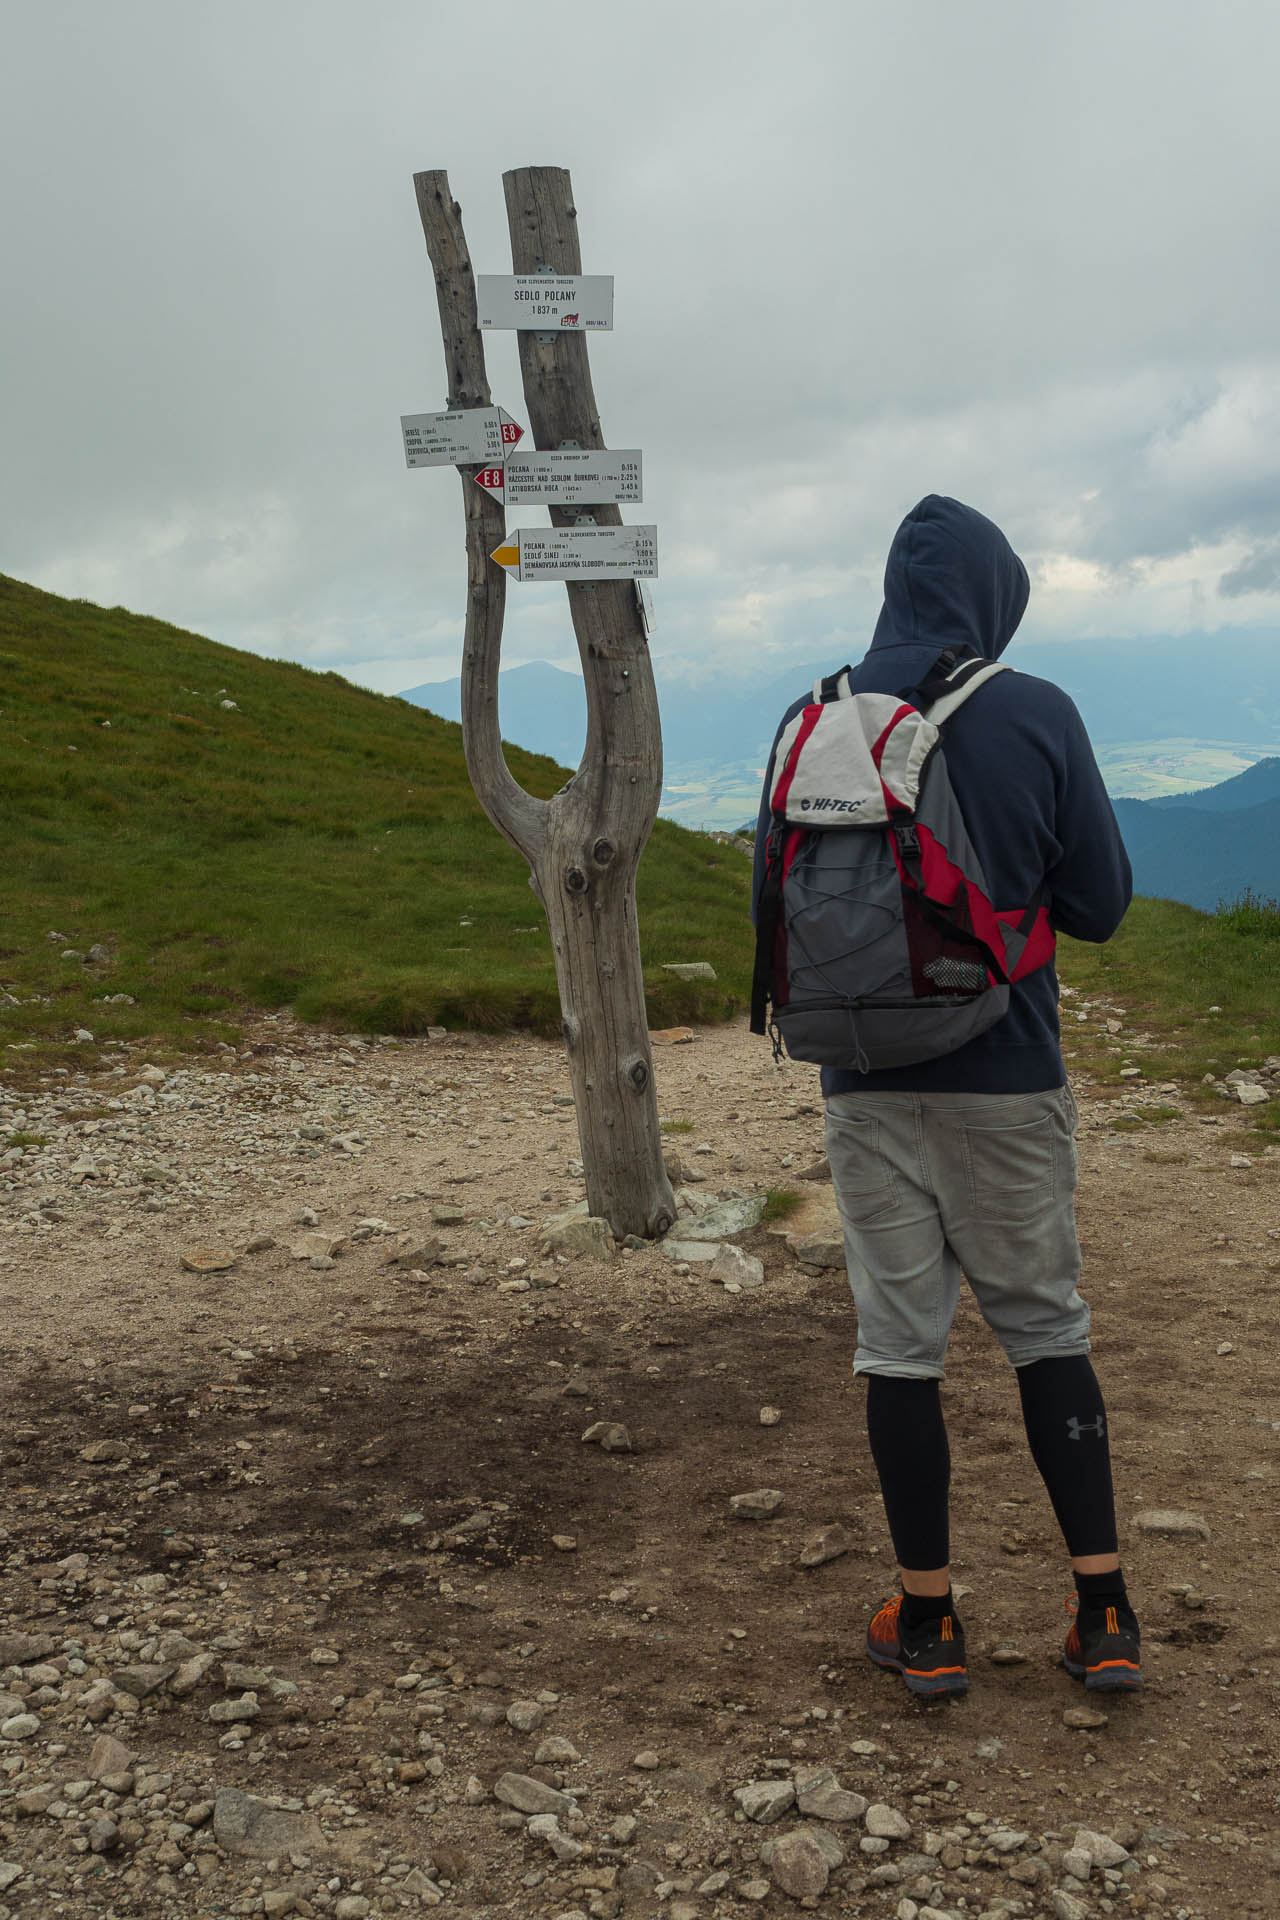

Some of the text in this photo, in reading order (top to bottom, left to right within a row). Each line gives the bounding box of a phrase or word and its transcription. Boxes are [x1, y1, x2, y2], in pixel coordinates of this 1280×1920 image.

[514, 290, 576, 300] SEDLO POĽANY
[812, 799, 862, 812] HI-TEC
